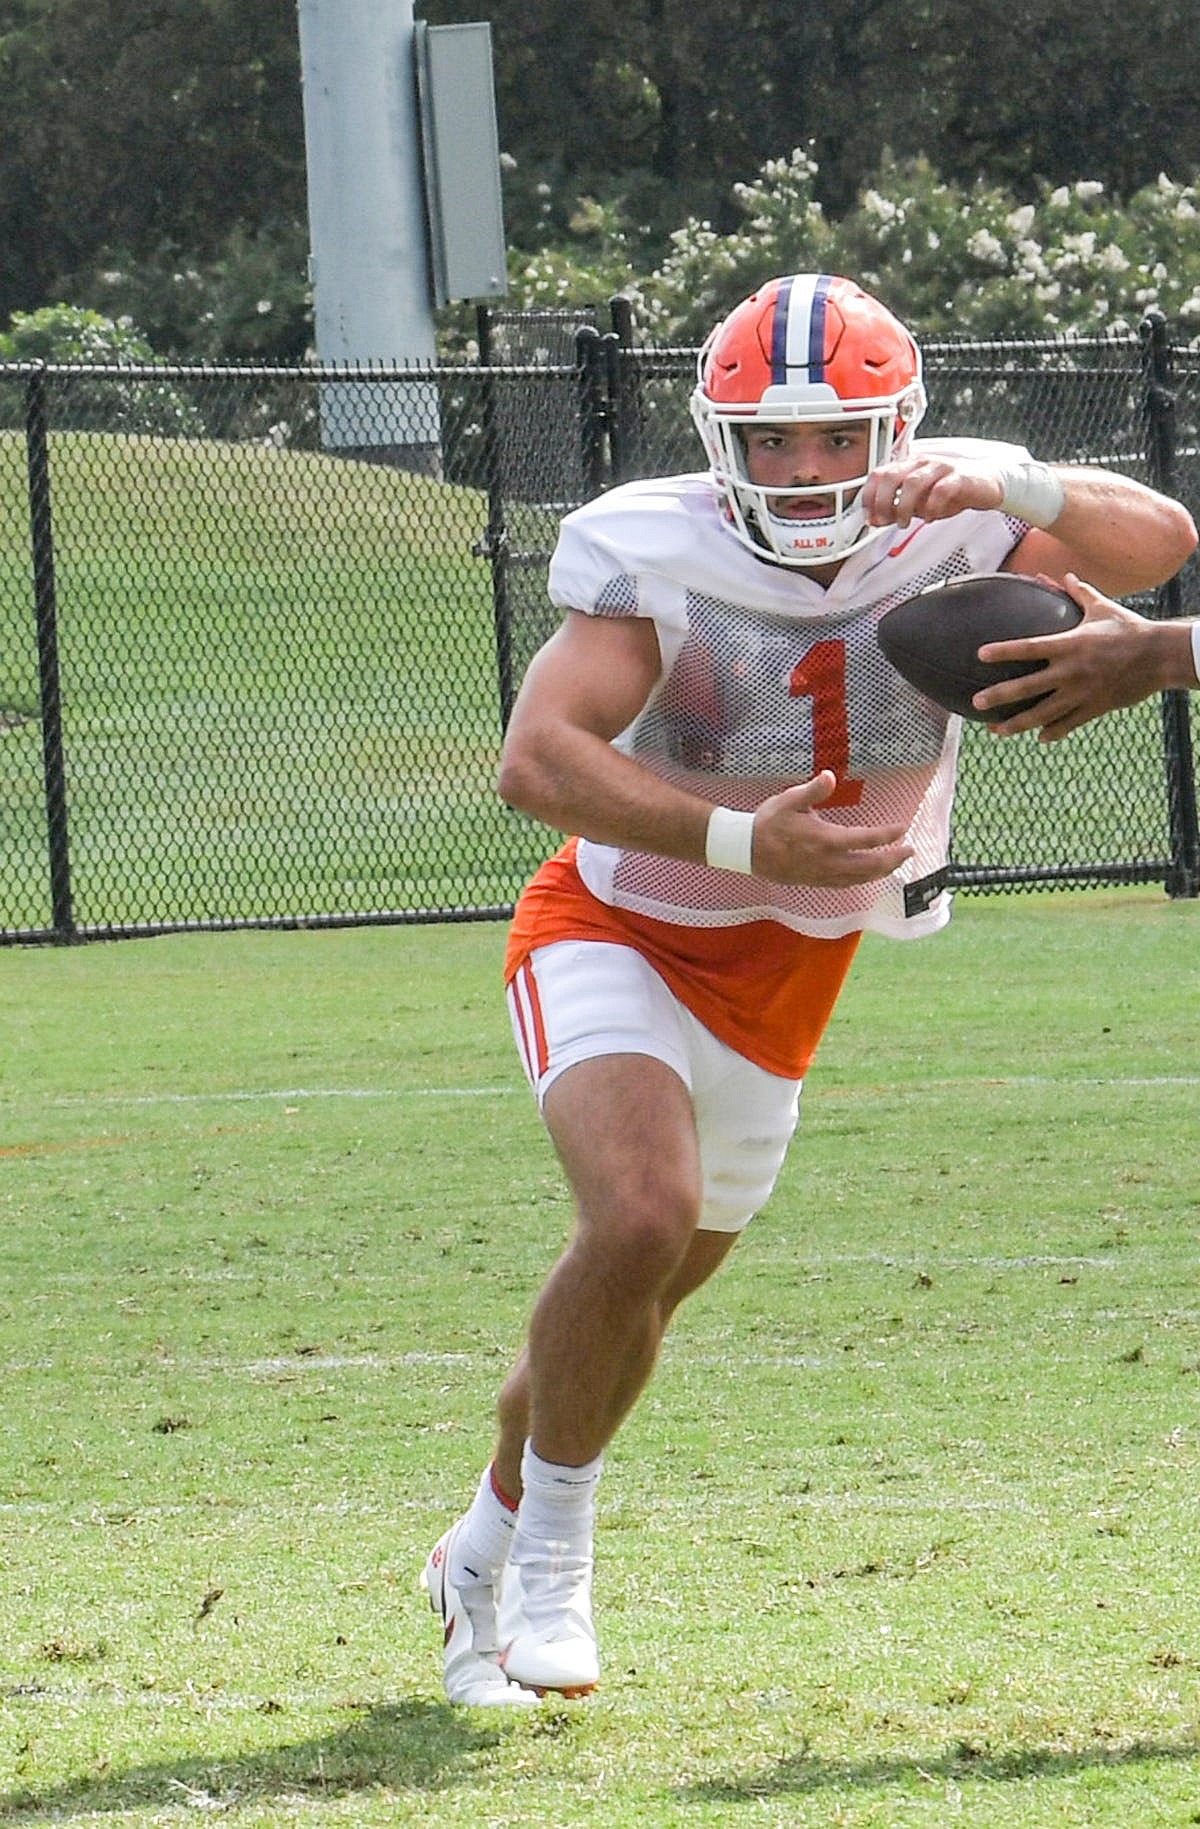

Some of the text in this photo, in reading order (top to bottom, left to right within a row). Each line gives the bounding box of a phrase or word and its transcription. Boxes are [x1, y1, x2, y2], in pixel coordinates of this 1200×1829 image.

[793, 536, 827, 549] ALL IN
[786, 639, 865, 810] 1
